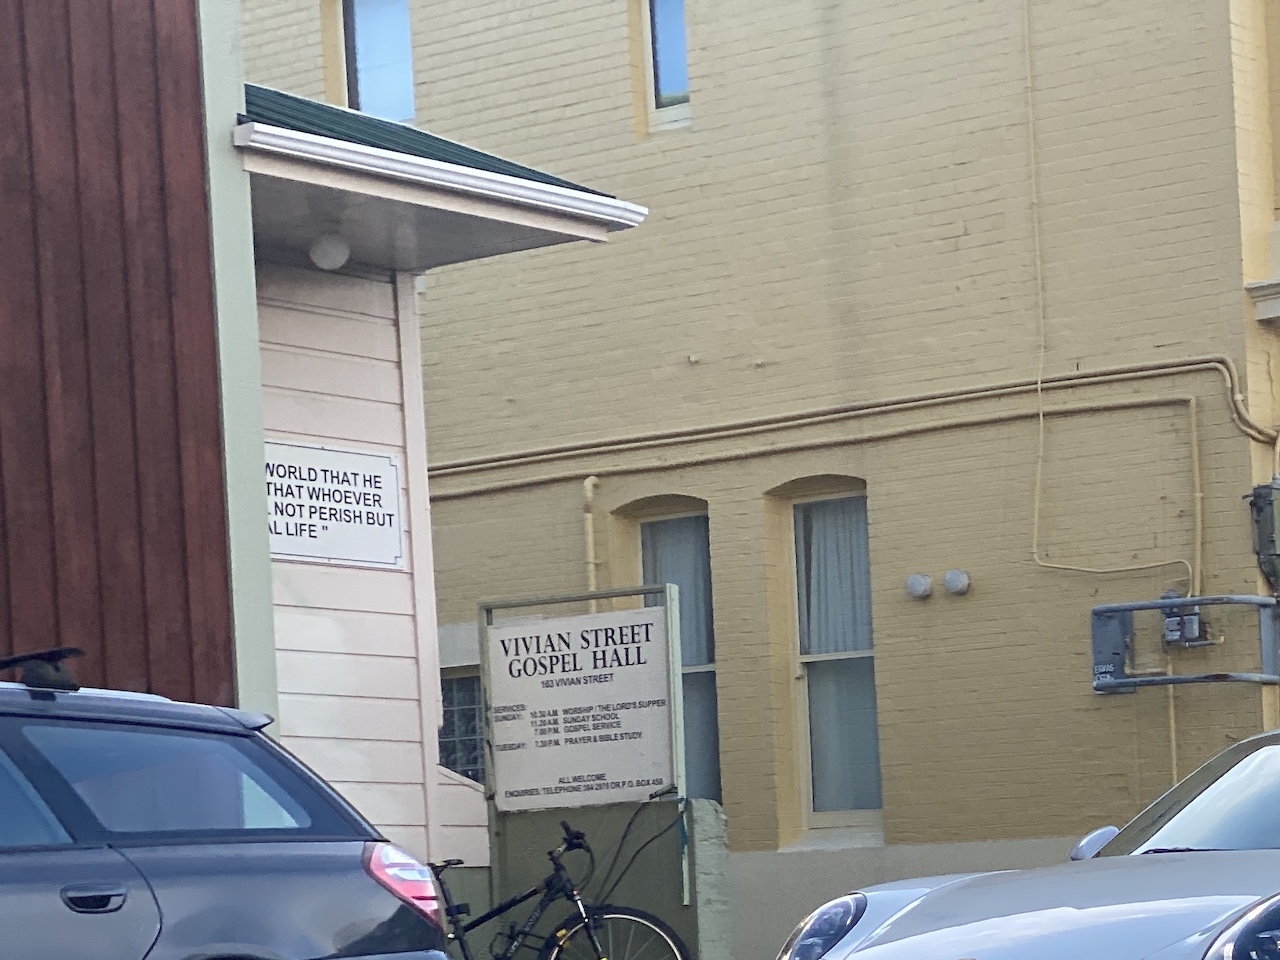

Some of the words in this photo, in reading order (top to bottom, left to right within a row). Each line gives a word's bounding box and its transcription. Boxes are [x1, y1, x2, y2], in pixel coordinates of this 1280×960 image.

[320, 468, 360, 487] THAT
[363, 473, 382, 490] HE
[266, 481, 304, 499] THAT
[307, 486, 383, 508] WHOEVER
[274, 501, 305, 518] NOT
[309, 505, 363, 525] PERISH
[367, 512, 395, 528] BUT
[286, 522, 318, 539] LIFE
[500, 631, 571, 657] VIVIAN
[580, 622, 654, 650] STREET
[508, 652, 583, 679] GOSPEL
[591, 645, 647, 670] HALL
[541, 679, 555, 688] 163
[555, 676, 583, 688] VIVIAN
[583, 672, 615, 686] STREET
[562, 705, 594, 716] WORSHIP
[597, 703, 611, 713] THE
[612, 701, 637, 711] LORD'S
[638, 699, 666, 710] SUPPER
[562, 715, 590, 725] SUNDAY
[591, 712, 620, 722] SCHOOL
[563, 723, 591, 733] GOSPEL
[592, 720, 622, 731] SERVICE
[564, 735, 592, 746] PRAYER
[598, 732, 619, 743] BIBLE
[619, 730, 643, 741] STUDY
[558, 776, 571, 785] ALL
[572, 773, 607, 783] WELCOME
[610, 780, 621, 790] OR
[636, 778, 651, 787] BOX
